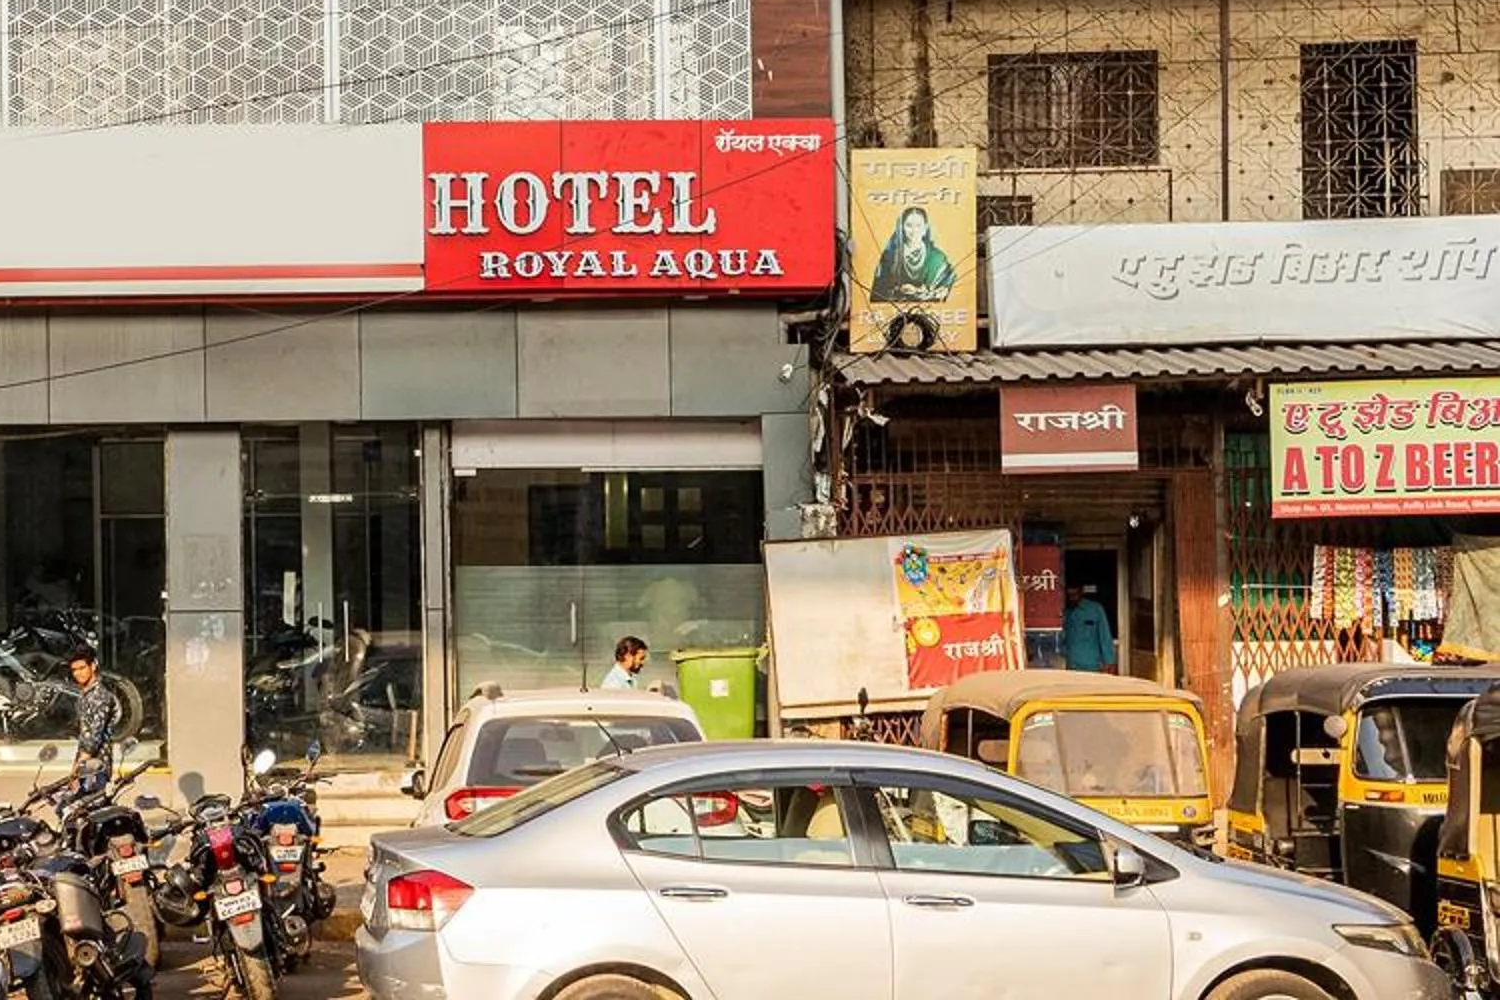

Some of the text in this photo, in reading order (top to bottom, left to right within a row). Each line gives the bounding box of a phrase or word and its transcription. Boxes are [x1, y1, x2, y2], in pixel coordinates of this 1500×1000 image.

[714, 128, 765, 153] रॉयल
[428, 171, 717, 235] HOTEL
[479, 249, 784, 280] ROYAL AQUA
[1012, 404, 1128, 432] राजश्री
[1283, 402, 1312, 434] ए
[1282, 442, 1500, 493] A TO Z BEER
